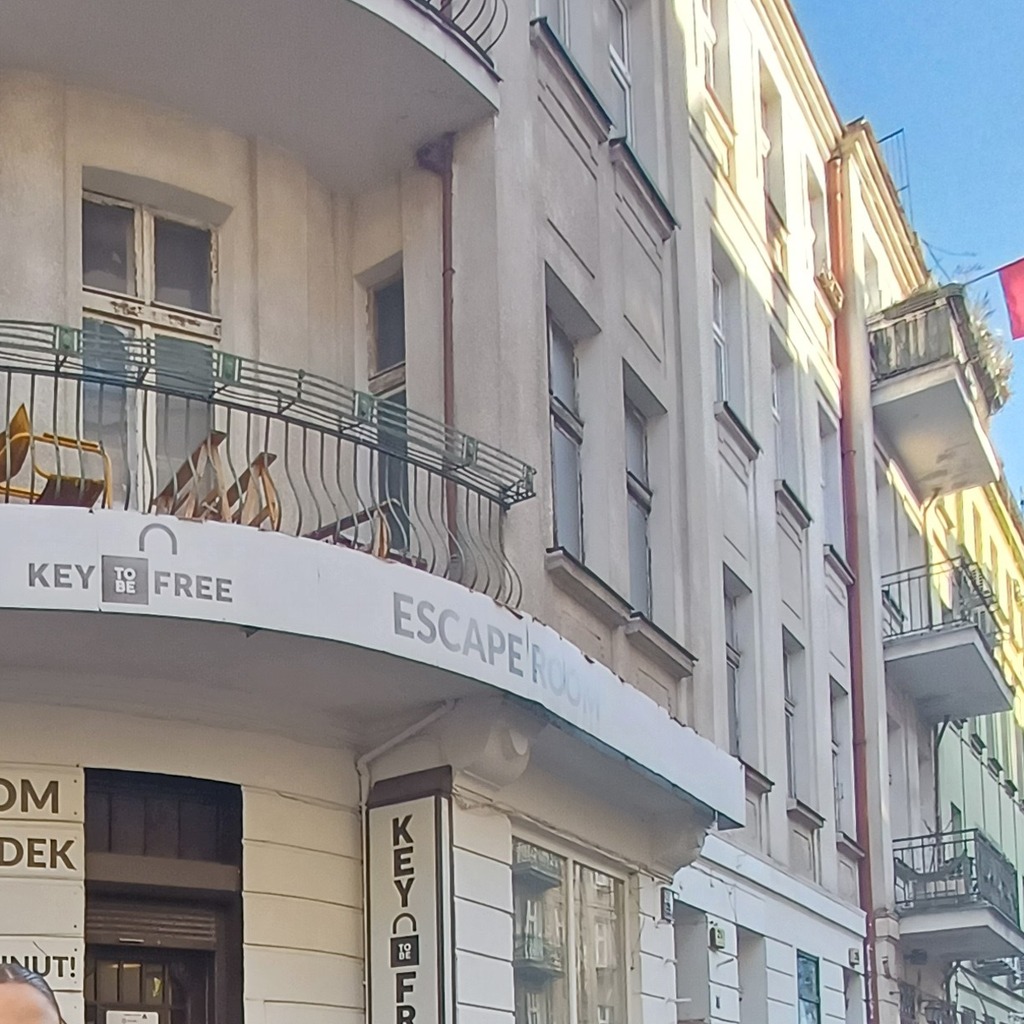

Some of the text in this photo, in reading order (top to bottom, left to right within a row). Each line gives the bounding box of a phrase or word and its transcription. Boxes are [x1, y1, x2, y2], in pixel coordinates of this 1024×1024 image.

[28, 562, 233, 602] KEY TO BE FREE
[393, 591, 524, 678] ESCAPE
[392, 814, 415, 908] KEY
